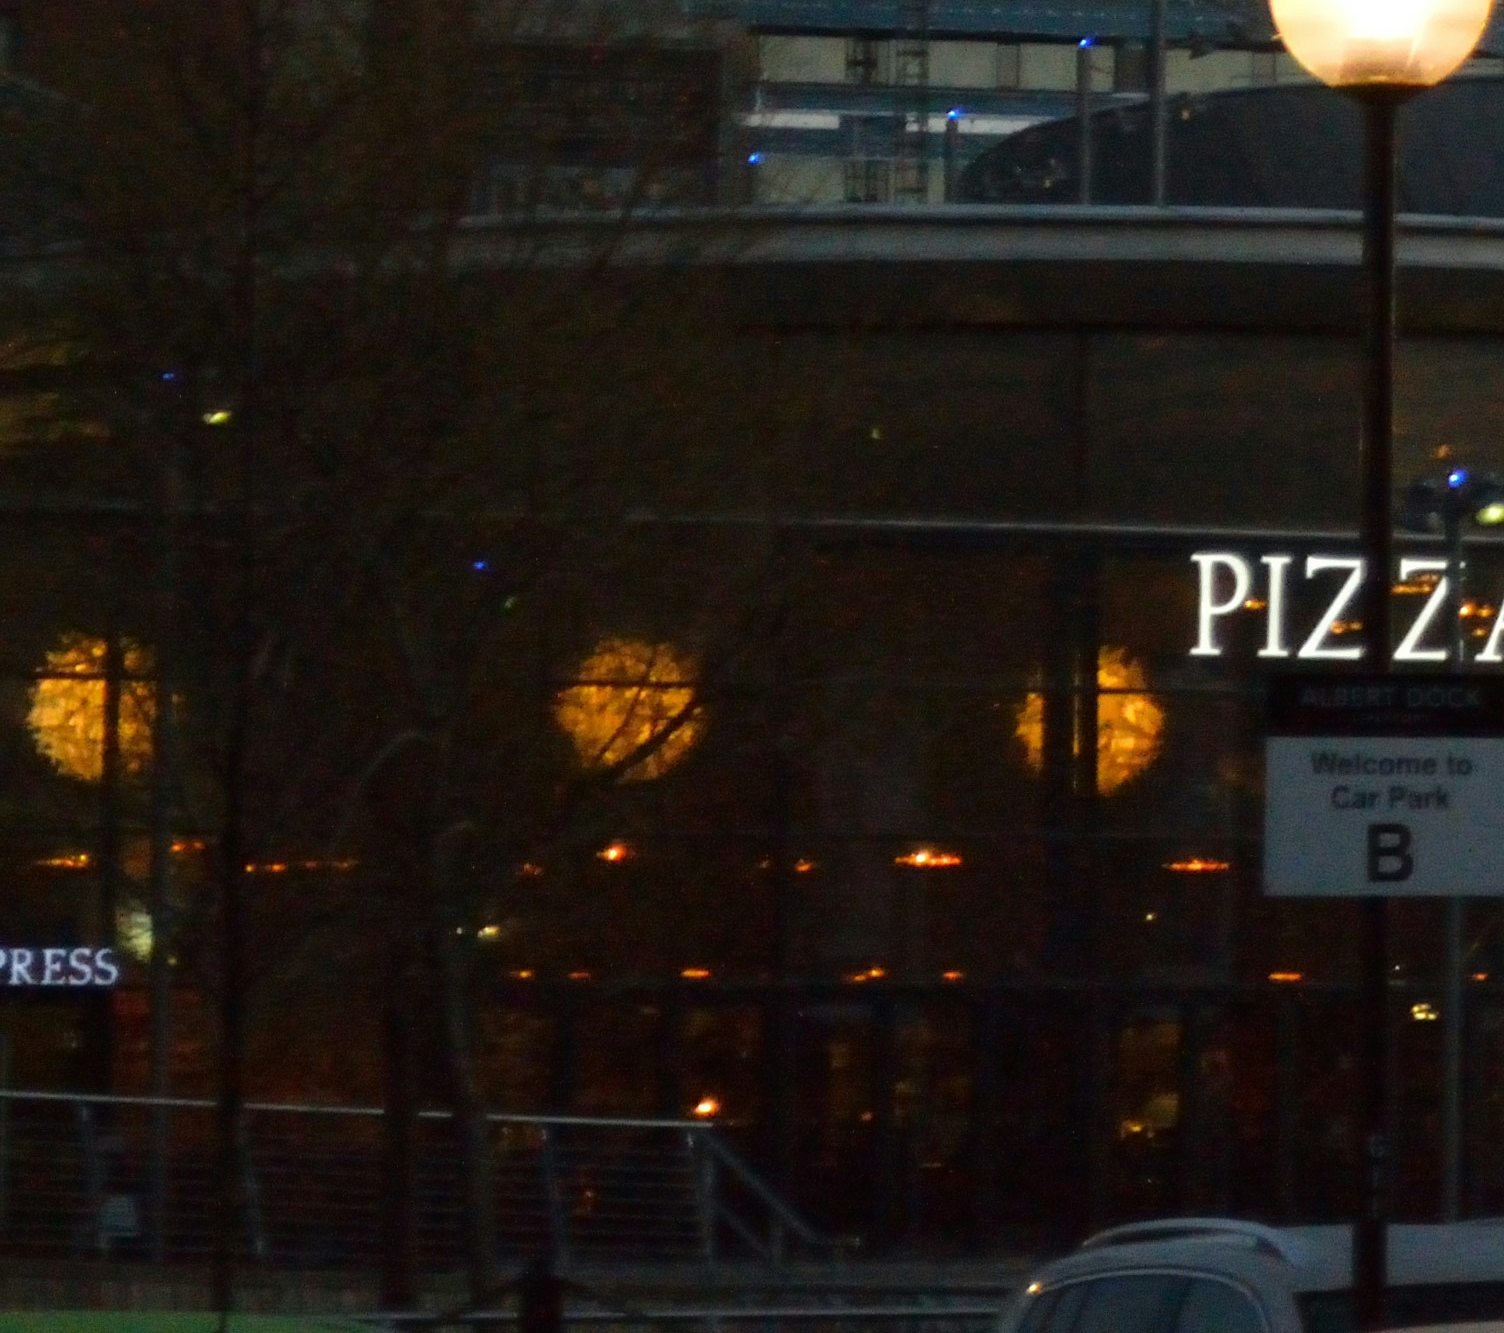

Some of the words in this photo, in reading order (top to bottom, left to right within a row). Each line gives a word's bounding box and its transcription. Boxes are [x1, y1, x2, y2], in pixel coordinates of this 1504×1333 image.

[1311, 752, 1437, 776] Welcome
[1447, 753, 1473, 776] to
[1331, 785, 1380, 810] Car
[1389, 785, 1450, 810] Park
[1366, 823, 1415, 883] B
